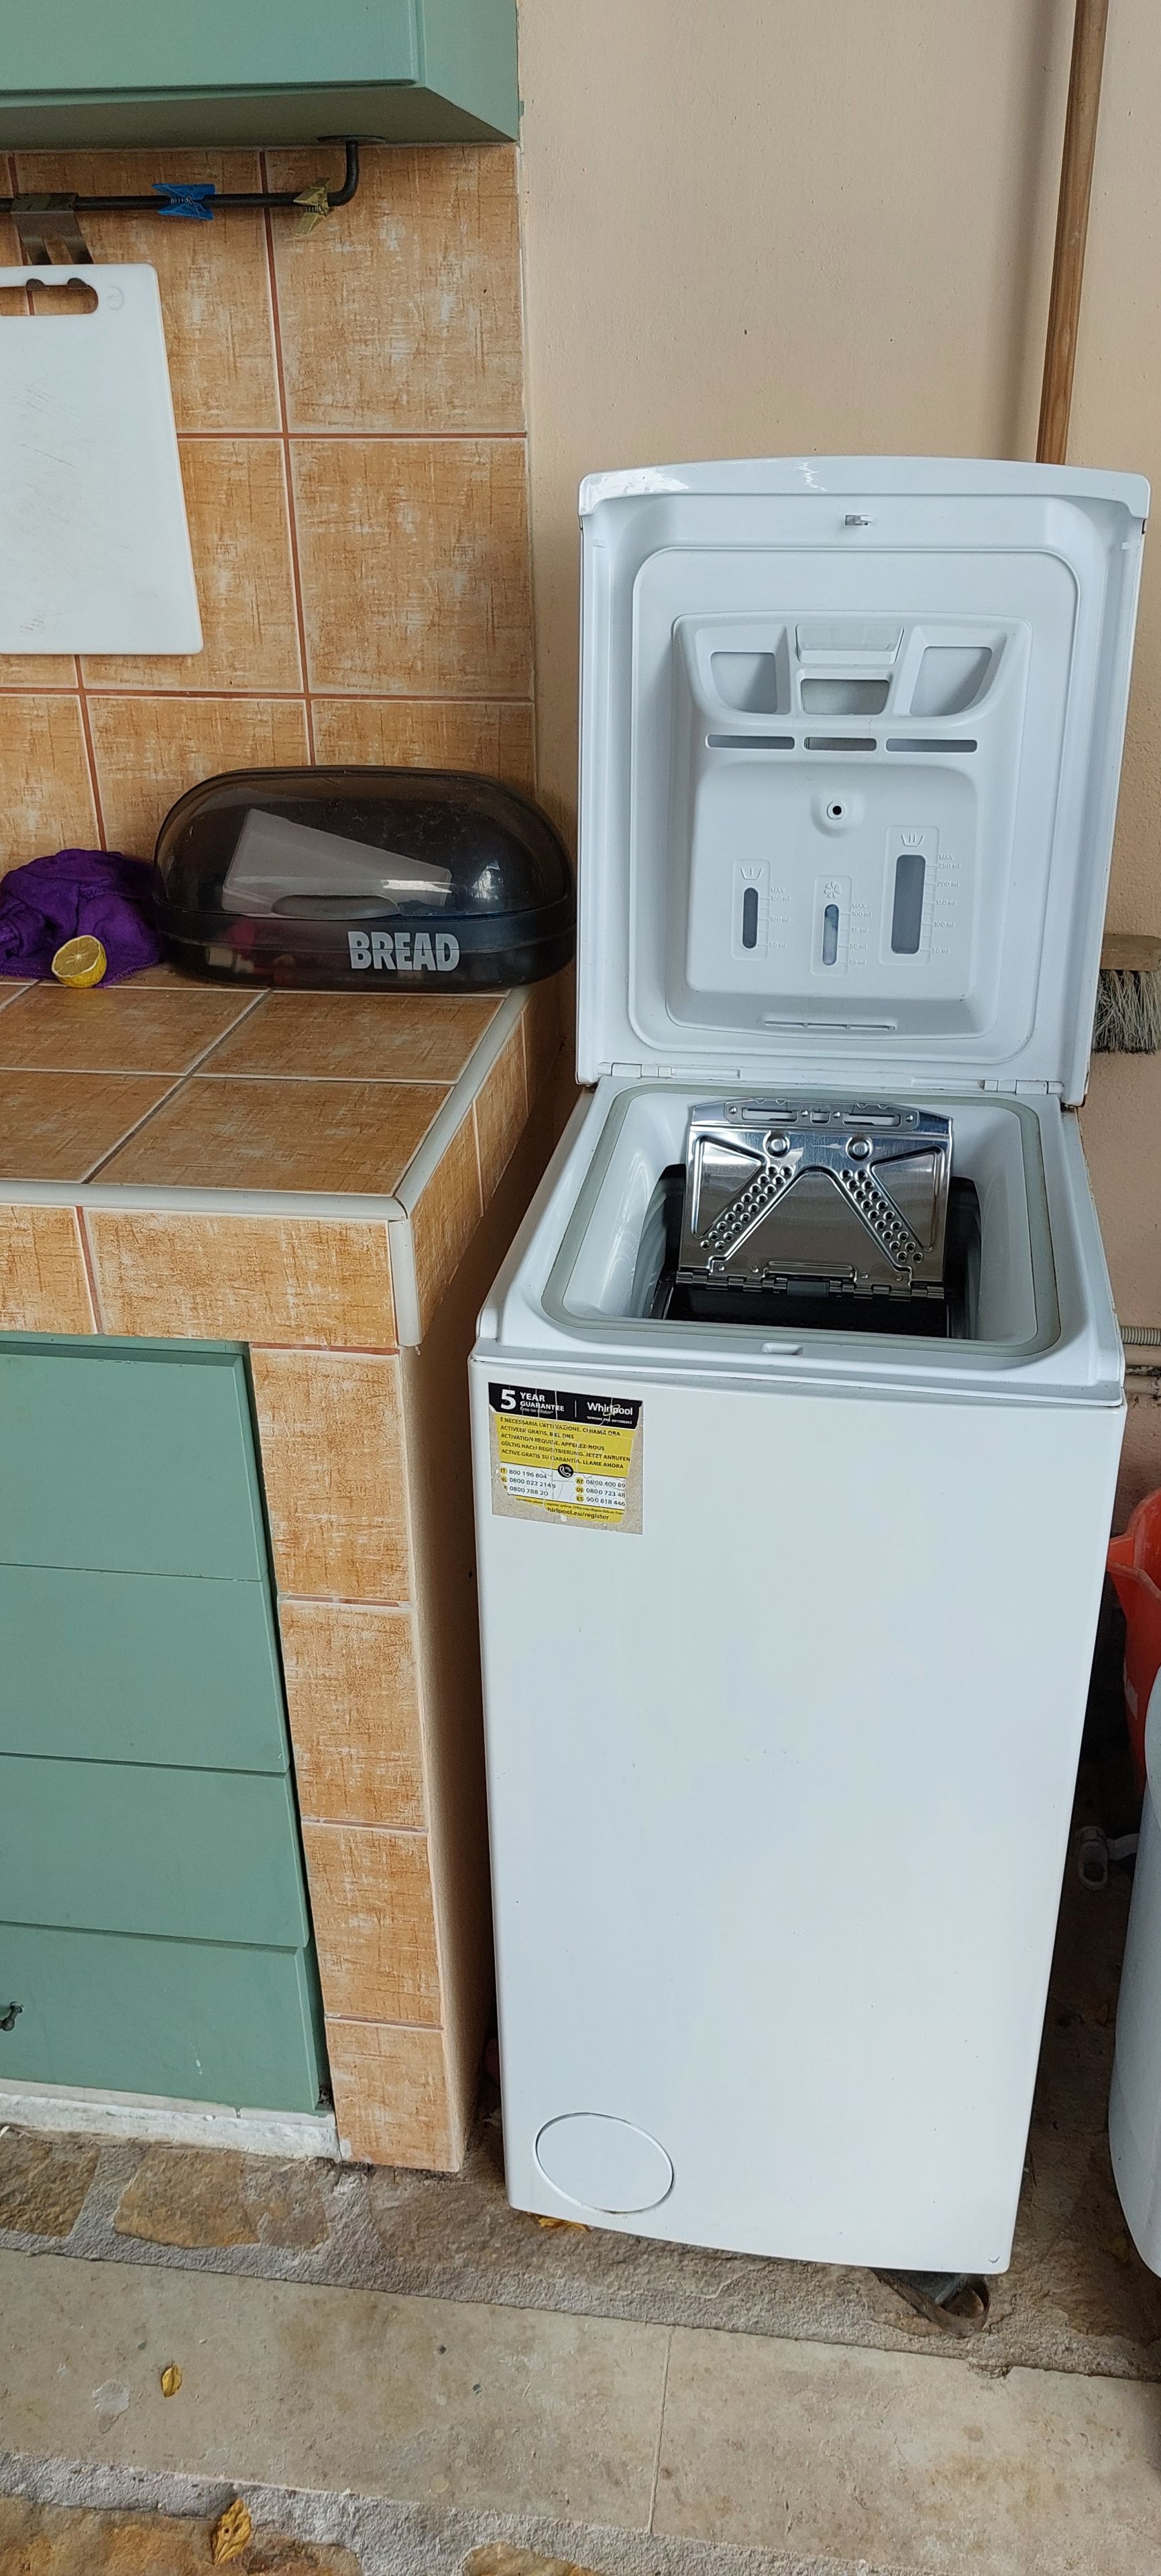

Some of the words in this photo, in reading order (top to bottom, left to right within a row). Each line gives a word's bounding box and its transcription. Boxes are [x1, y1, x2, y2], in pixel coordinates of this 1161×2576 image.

[347, 931, 459, 971] BREAD
[500, 1389, 516, 1410] 5
[520, 1391, 545, 1402] YEAR
[520, 1401, 565, 1411] GUARANTEE
[586, 1402, 633, 1415] Whirlpool
[500, 1425, 527, 1433] ACTIVEER
[504, 1417, 538, 1427] NECESSARIA
[582, 1428, 607, 1436] CHIAMA
[500, 1433, 534, 1442] ACTIVATION
[561, 1441, 605, 1450] APPELEZ-NOUS
[500, 1440, 520, 1448] GÜLTIG
[539, 1481, 556, 1489] 2149
[546, 1507, 609, 1520] hirlpool.eu/register
